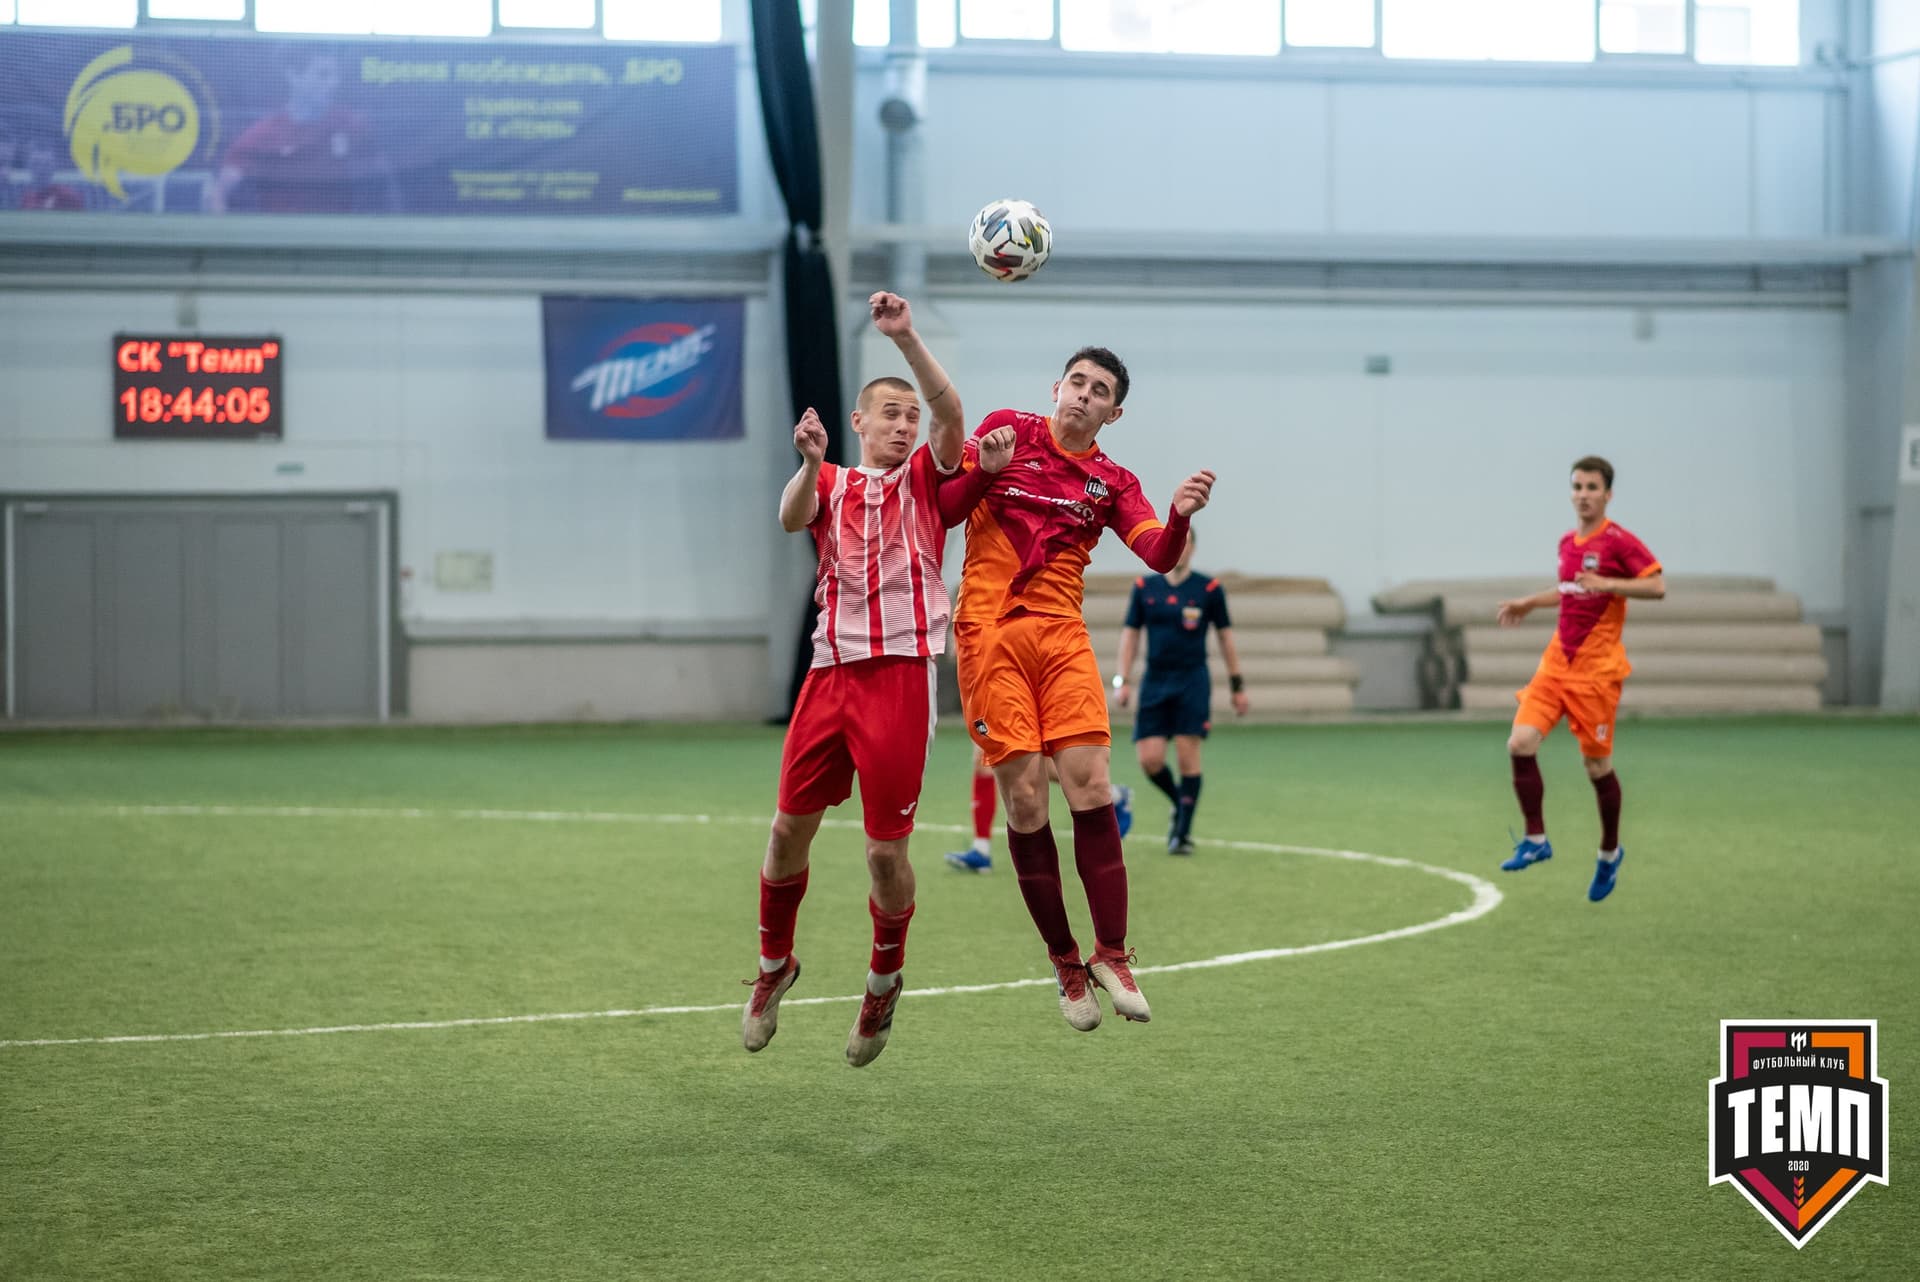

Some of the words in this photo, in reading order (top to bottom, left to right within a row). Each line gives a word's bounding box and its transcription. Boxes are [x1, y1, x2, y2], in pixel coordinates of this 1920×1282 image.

[118, 341, 162, 372] СК
[168, 341, 279, 373] "Темп"
[120, 386, 270, 423] 18:44:05
